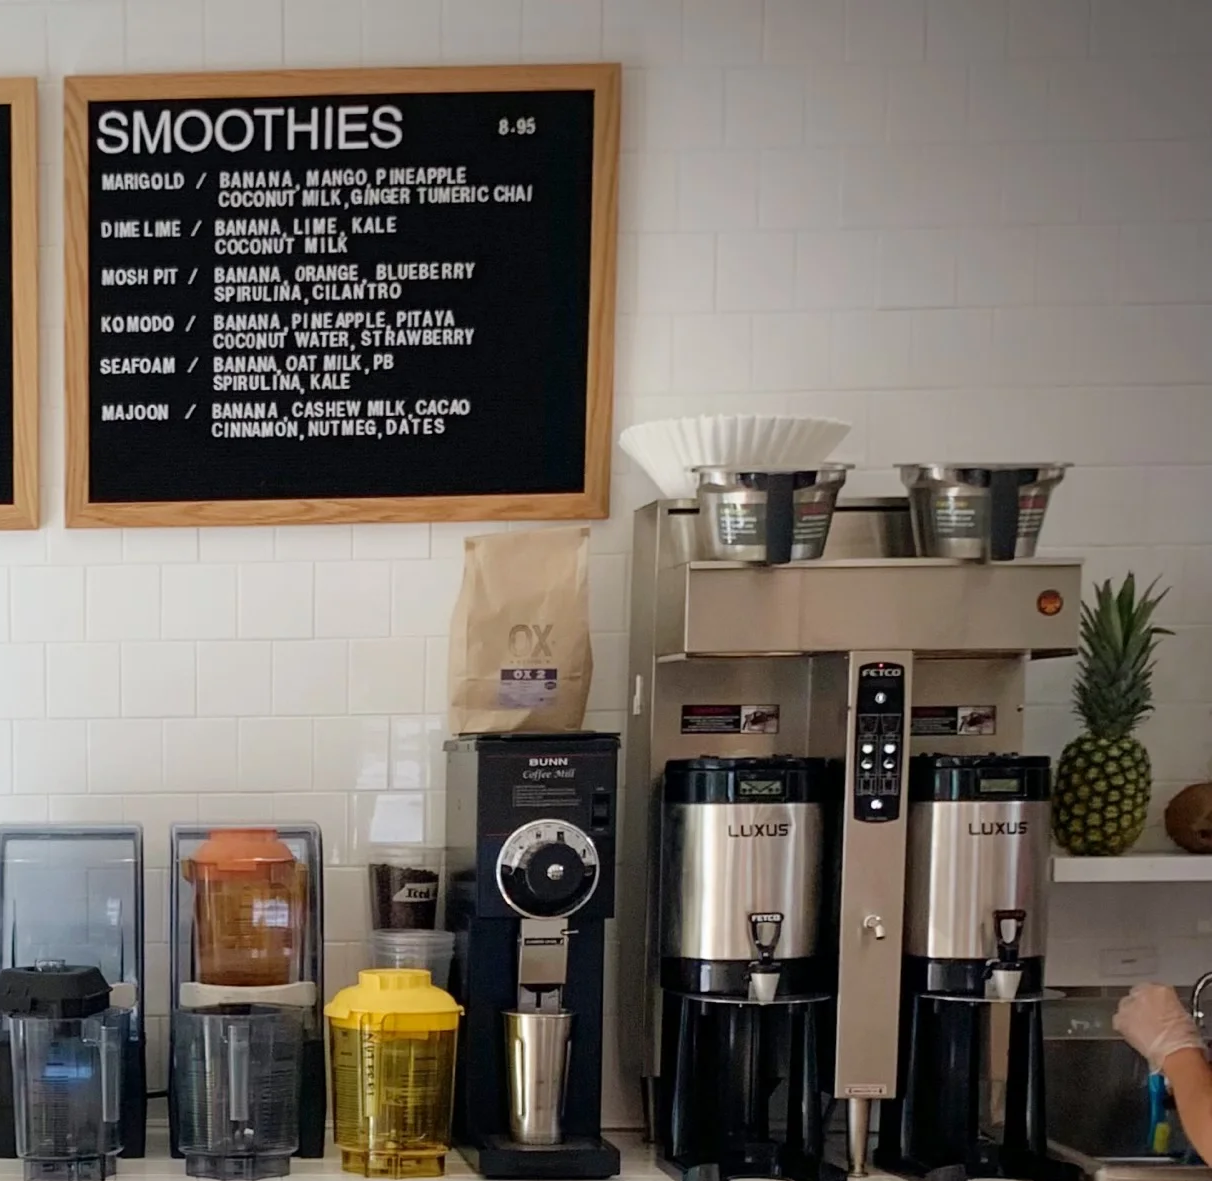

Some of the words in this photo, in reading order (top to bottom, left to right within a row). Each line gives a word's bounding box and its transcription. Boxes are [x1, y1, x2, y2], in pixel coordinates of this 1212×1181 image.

[97, 106, 402, 154] SMOOTHIES
[499, 118, 535, 135] 8.95
[102, 172, 184, 190] MARIGOLD
[376, 167, 466, 185] PINEAPPLE
[218, 189, 298, 208] COCONUT
[351, 186, 410, 205] GINGER
[417, 186, 489, 204] TUMERIC
[144, 220, 181, 237] LIME
[352, 216, 396, 233] KALE
[215, 237, 295, 255] COCONUT
[305, 235, 347, 253] MILK
[101, 269, 148, 286] MOSH
[154, 268, 178, 285] PIT
[376, 262, 475, 280] BLUEBERRY
[312, 282, 402, 300] CILANTRO
[101, 315, 174, 333] KOMODO
[396, 310, 455, 328] PITAYA
[213, 331, 288, 350] COCONUT
[361, 327, 474, 347] STRAWBERRY
[100, 357, 175, 374] SEAFOAM
[285, 355, 317, 371] OAT
[373, 354, 394, 370] PB
[310, 373, 350, 390] KALE
[102, 404, 169, 421] MAJOON
[292, 400, 361, 418] CASHEW
[415, 399, 470, 415] CACAO
[386, 417, 445, 435] DATES
[508, 624, 553, 657] OX
[513, 671, 531, 680] OX
[536, 671, 546, 680] 2
[862, 668, 901, 677] FETCO
[529, 758, 568, 766] BUNN
[522, 768, 552, 781] Coffee
[554, 768, 576, 778] Mill
[728, 824, 789, 837] LUXUS
[968, 821, 1029, 836] LUXUS
